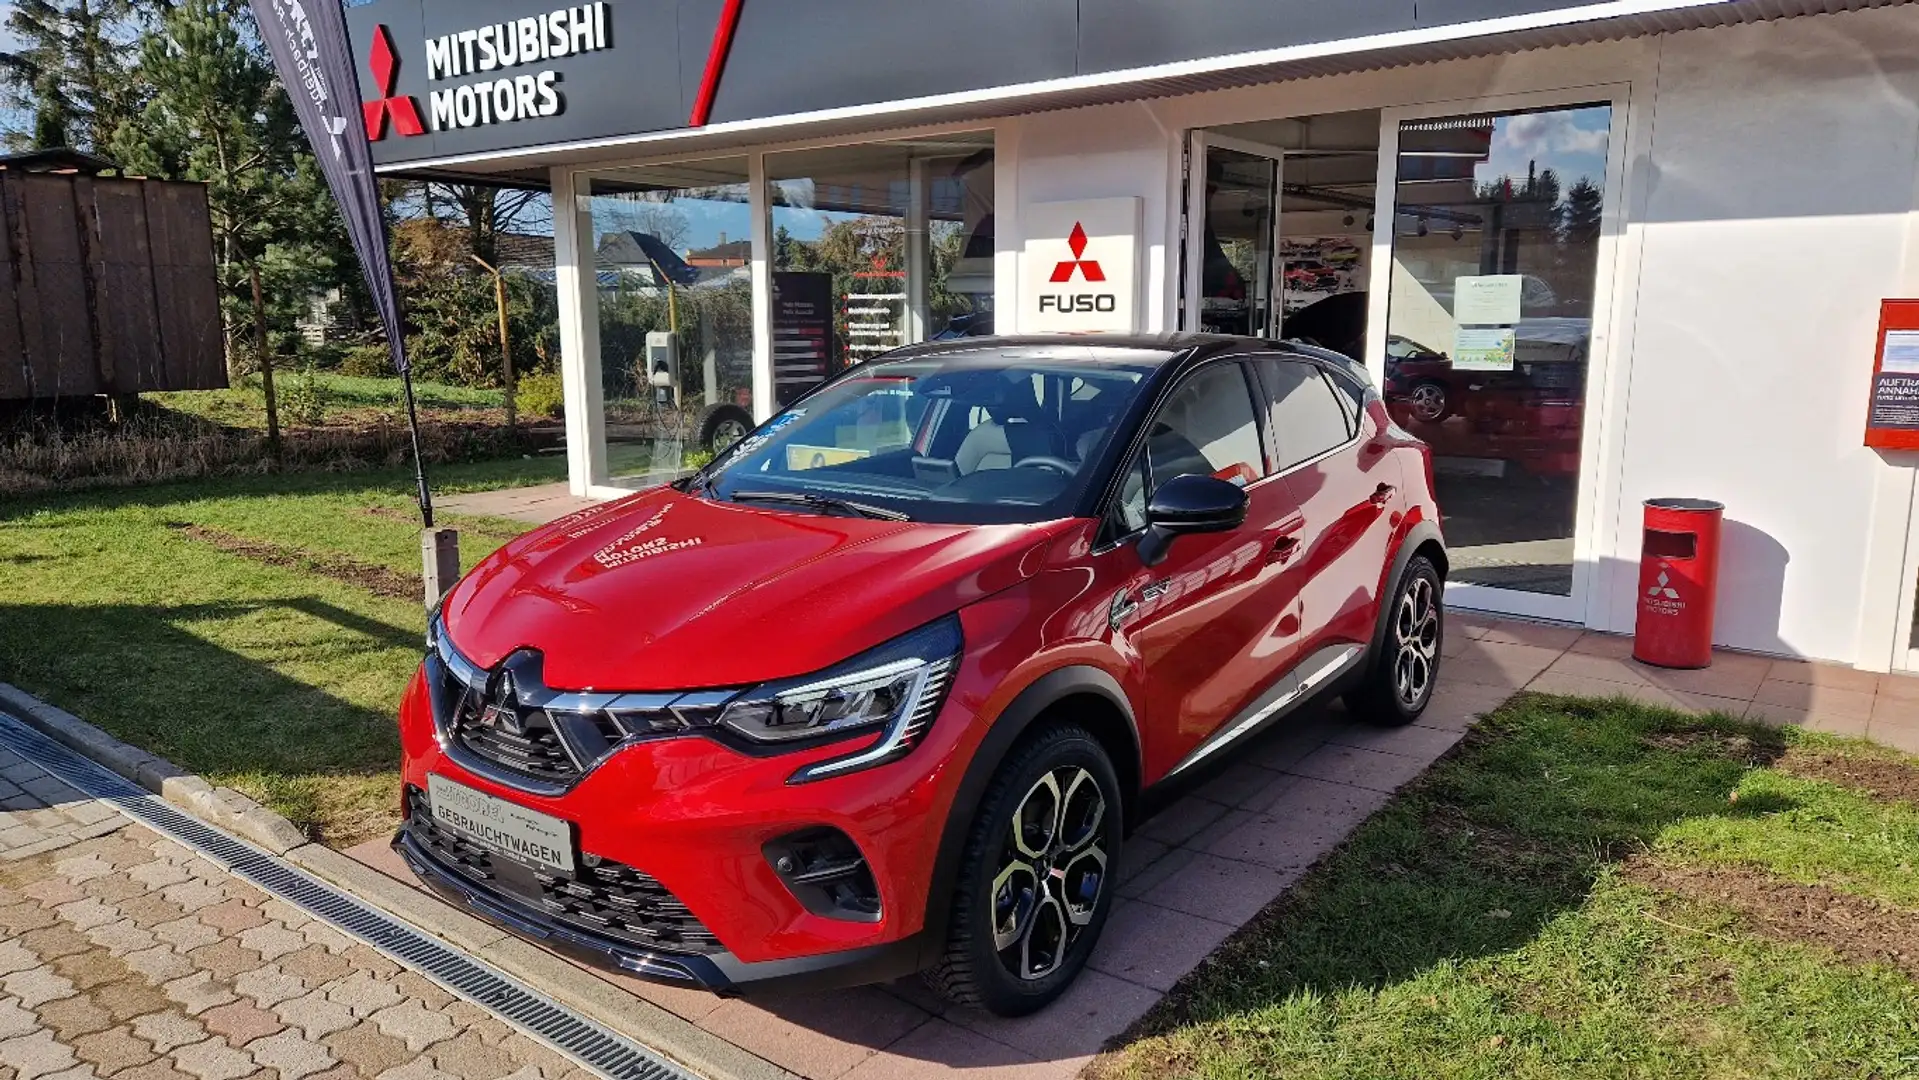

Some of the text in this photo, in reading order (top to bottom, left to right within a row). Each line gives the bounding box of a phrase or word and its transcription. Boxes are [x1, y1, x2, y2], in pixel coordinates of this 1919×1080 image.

[425, 1, 607, 81] MITSUBISHI
[429, 70, 558, 131] MOTORS
[1038, 294, 1115, 313] FUSO
[1877, 386, 1919, 395] ANNAH
[438, 805, 562, 865] GEBRAUCHTWAGEN
